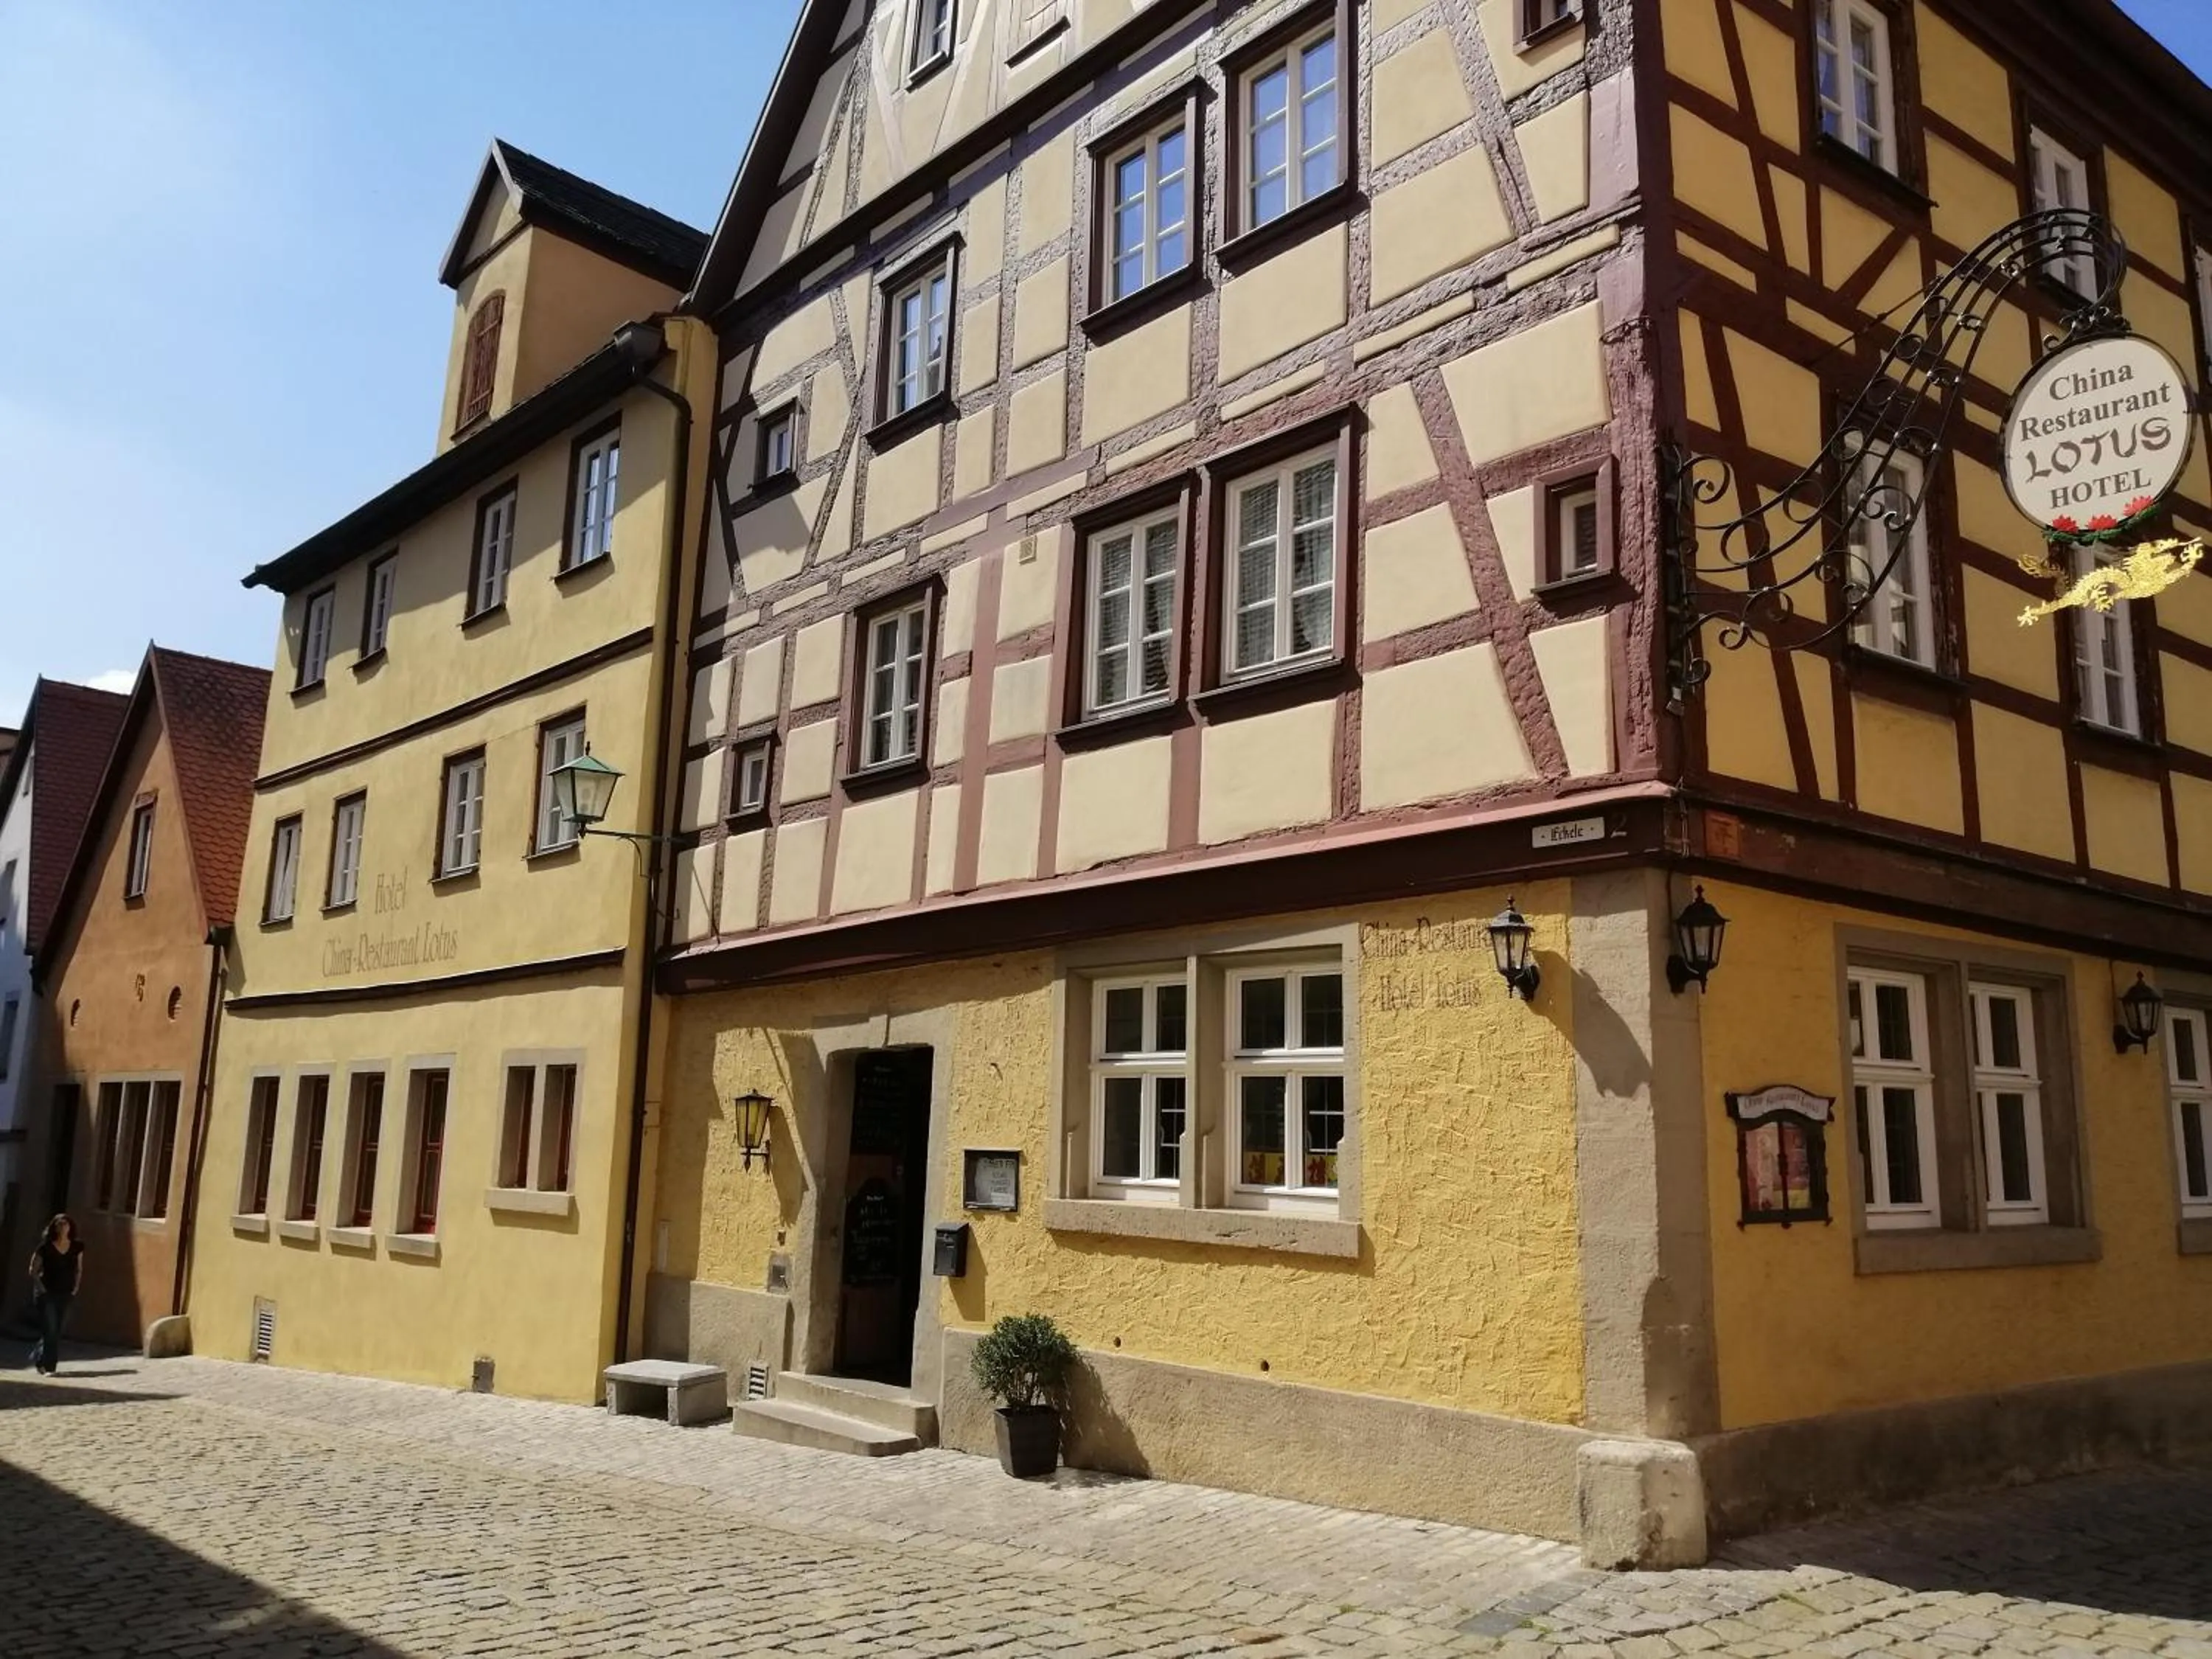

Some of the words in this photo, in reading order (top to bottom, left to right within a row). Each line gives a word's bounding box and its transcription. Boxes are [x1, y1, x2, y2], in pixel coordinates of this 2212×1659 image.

[2049, 364, 2134, 401] China
[2020, 382, 2171, 442] Restaurant
[2025, 417, 2171, 483] LOTUS
[2051, 467, 2152, 509] HOTEL
[375, 866, 408, 915] Hotel
[422, 922, 458, 963] Lotus
